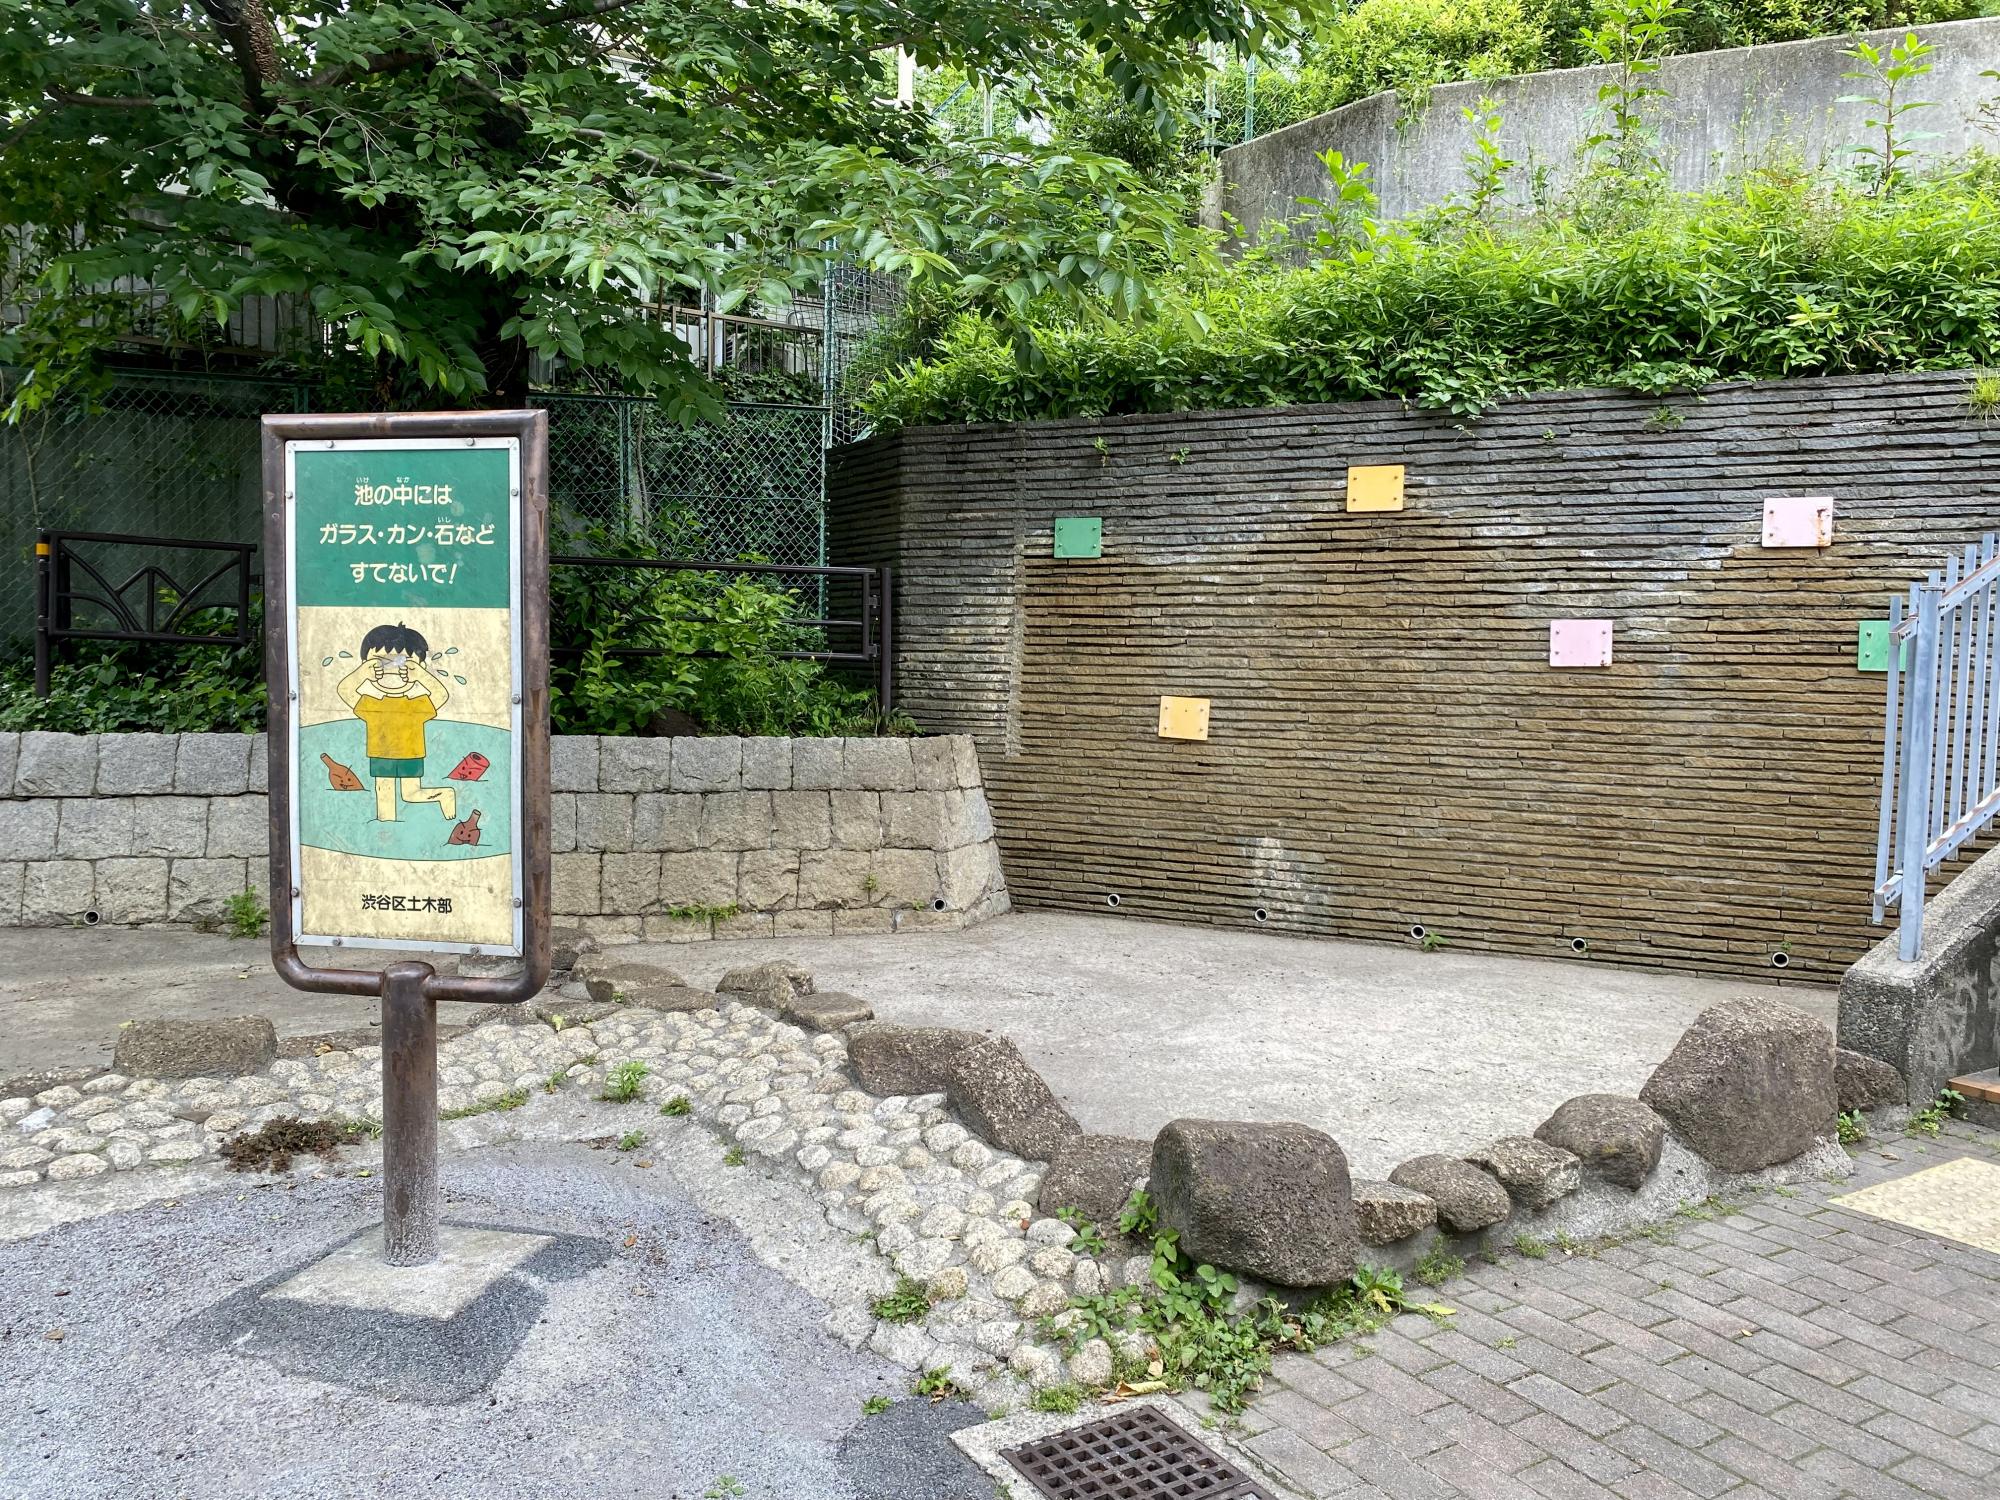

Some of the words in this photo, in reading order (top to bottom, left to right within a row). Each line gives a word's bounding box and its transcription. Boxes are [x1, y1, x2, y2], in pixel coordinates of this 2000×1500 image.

[354, 484, 453, 506] 池の中には
[319, 523, 495, 545] ガラス・カン・石など
[361, 894, 453, 914] 渋谷区土木部
